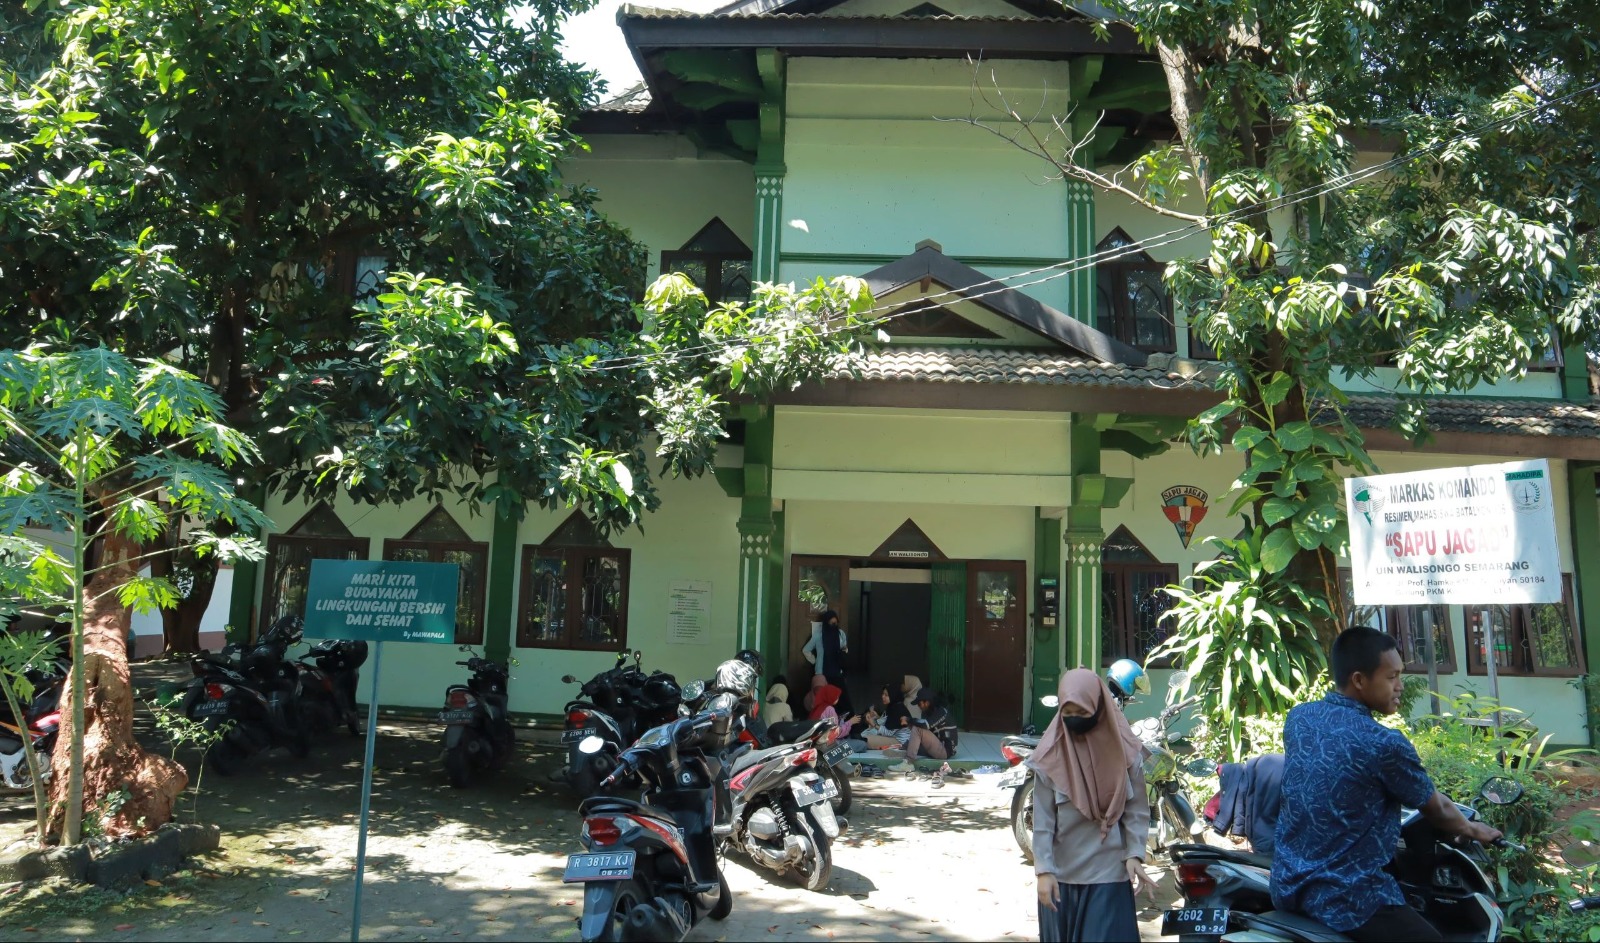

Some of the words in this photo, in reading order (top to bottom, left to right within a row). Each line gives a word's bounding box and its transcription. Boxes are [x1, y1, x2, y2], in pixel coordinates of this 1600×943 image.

[1163, 487, 1182, 500] SAPU
[1184, 487, 1207, 500] JAGAD
[1390, 482, 1435, 504] MARKAS
[1438, 476, 1496, 499] KOMANDO
[1384, 511, 1412, 523] RESIMEN
[1376, 566, 1394, 575] UIN
[1396, 564, 1461, 574] WALISONGO
[1464, 561, 1530, 572] SEMARANG
[351, 573, 386, 586] MARI
[387, 574, 416, 587] KITA
[1520, 576, 1545, 584] 50184
[344, 586, 419, 600] BUDAYAKAN
[316, 599, 397, 613] LINGKUNGAN
[399, 601, 447, 615] BERSIH
[346, 613, 373, 626] DAN
[373, 615, 414, 627] SEHAT
[403, 631, 411, 640] By
[412, 631, 445, 639] MAWAPALA
[574, 858, 581, 868] R
[587, 856, 612, 867] 3817
[614, 855, 628, 866] KJ
[1177, 909, 1203, 921] 2602
[1213, 909, 1228, 921] FJ
